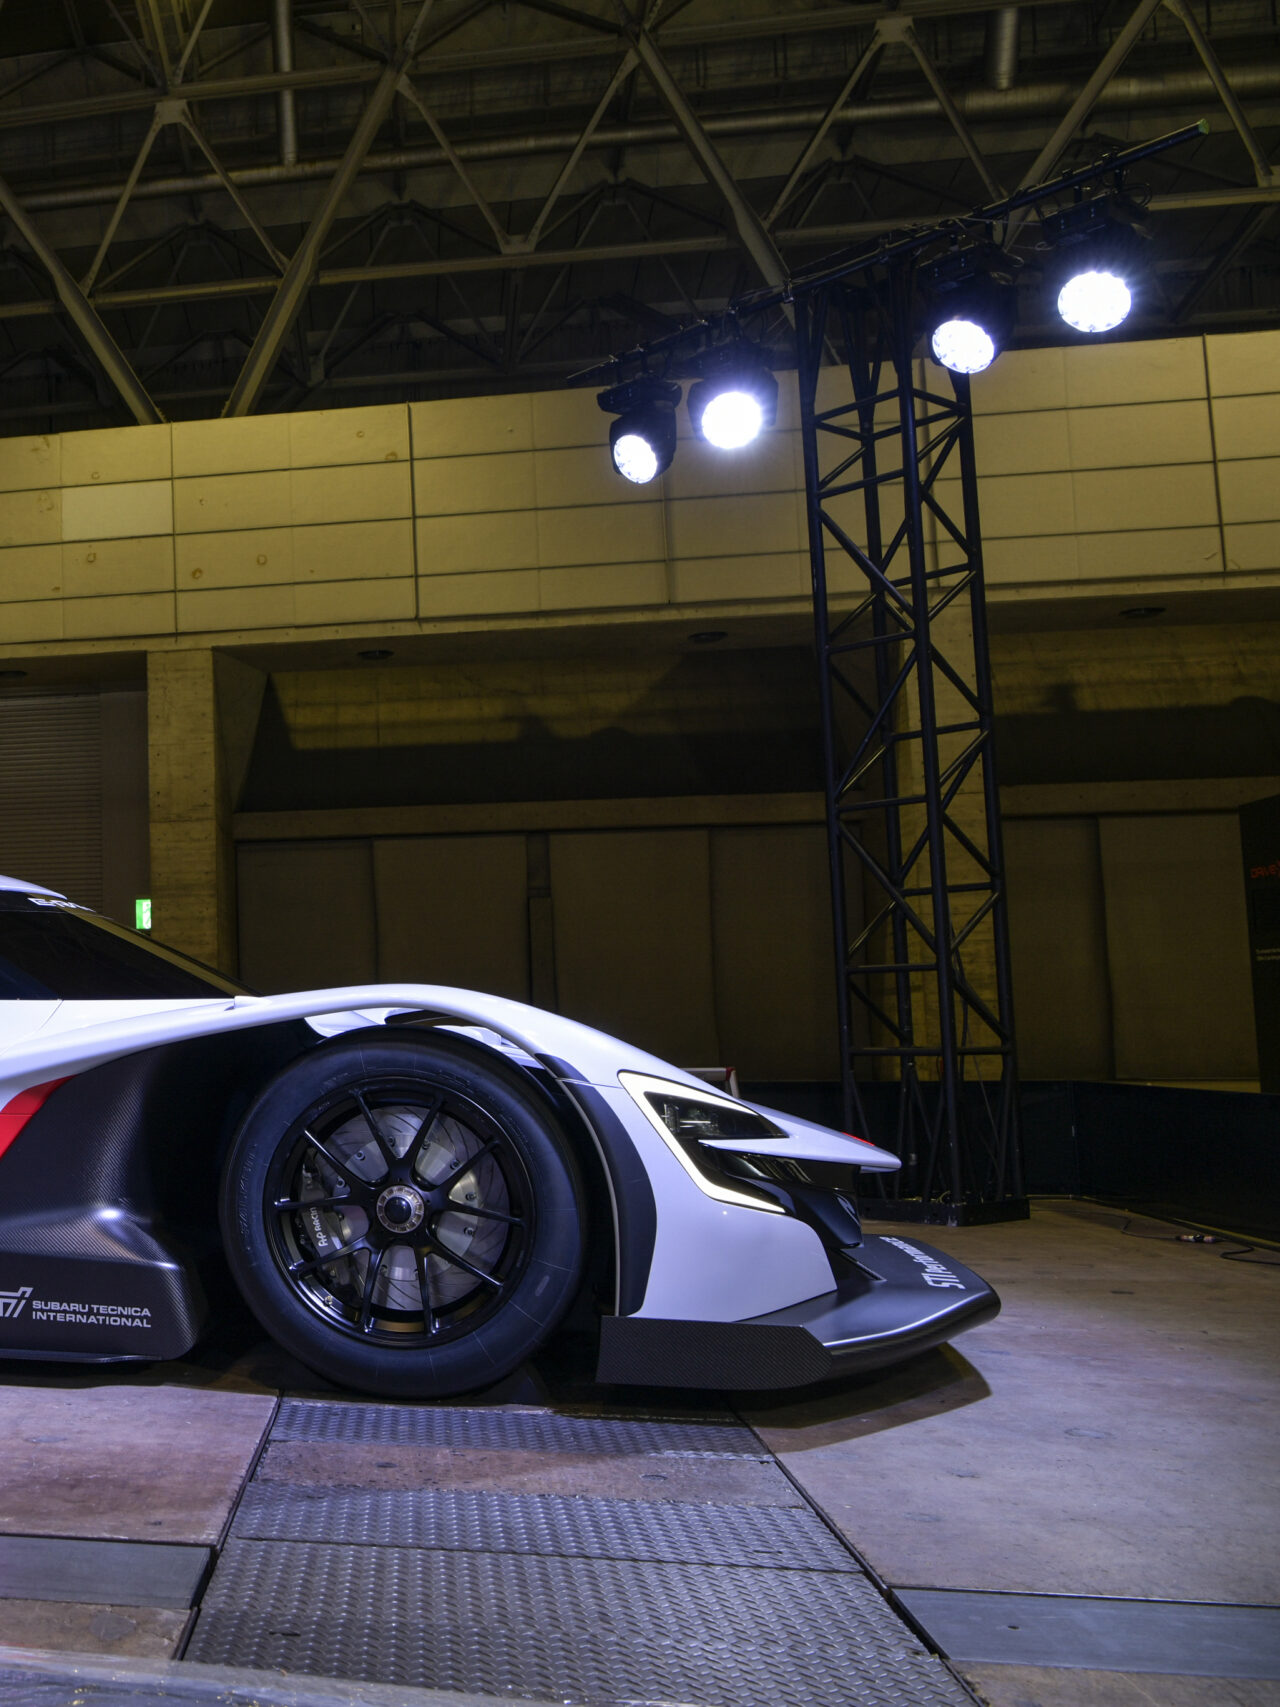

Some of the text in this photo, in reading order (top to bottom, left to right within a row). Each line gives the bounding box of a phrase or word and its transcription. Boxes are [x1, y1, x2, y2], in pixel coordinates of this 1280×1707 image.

[32, 1300, 151, 1317] SUBARU TECNICA
[32, 1311, 151, 1328] INTERNATIONAL
